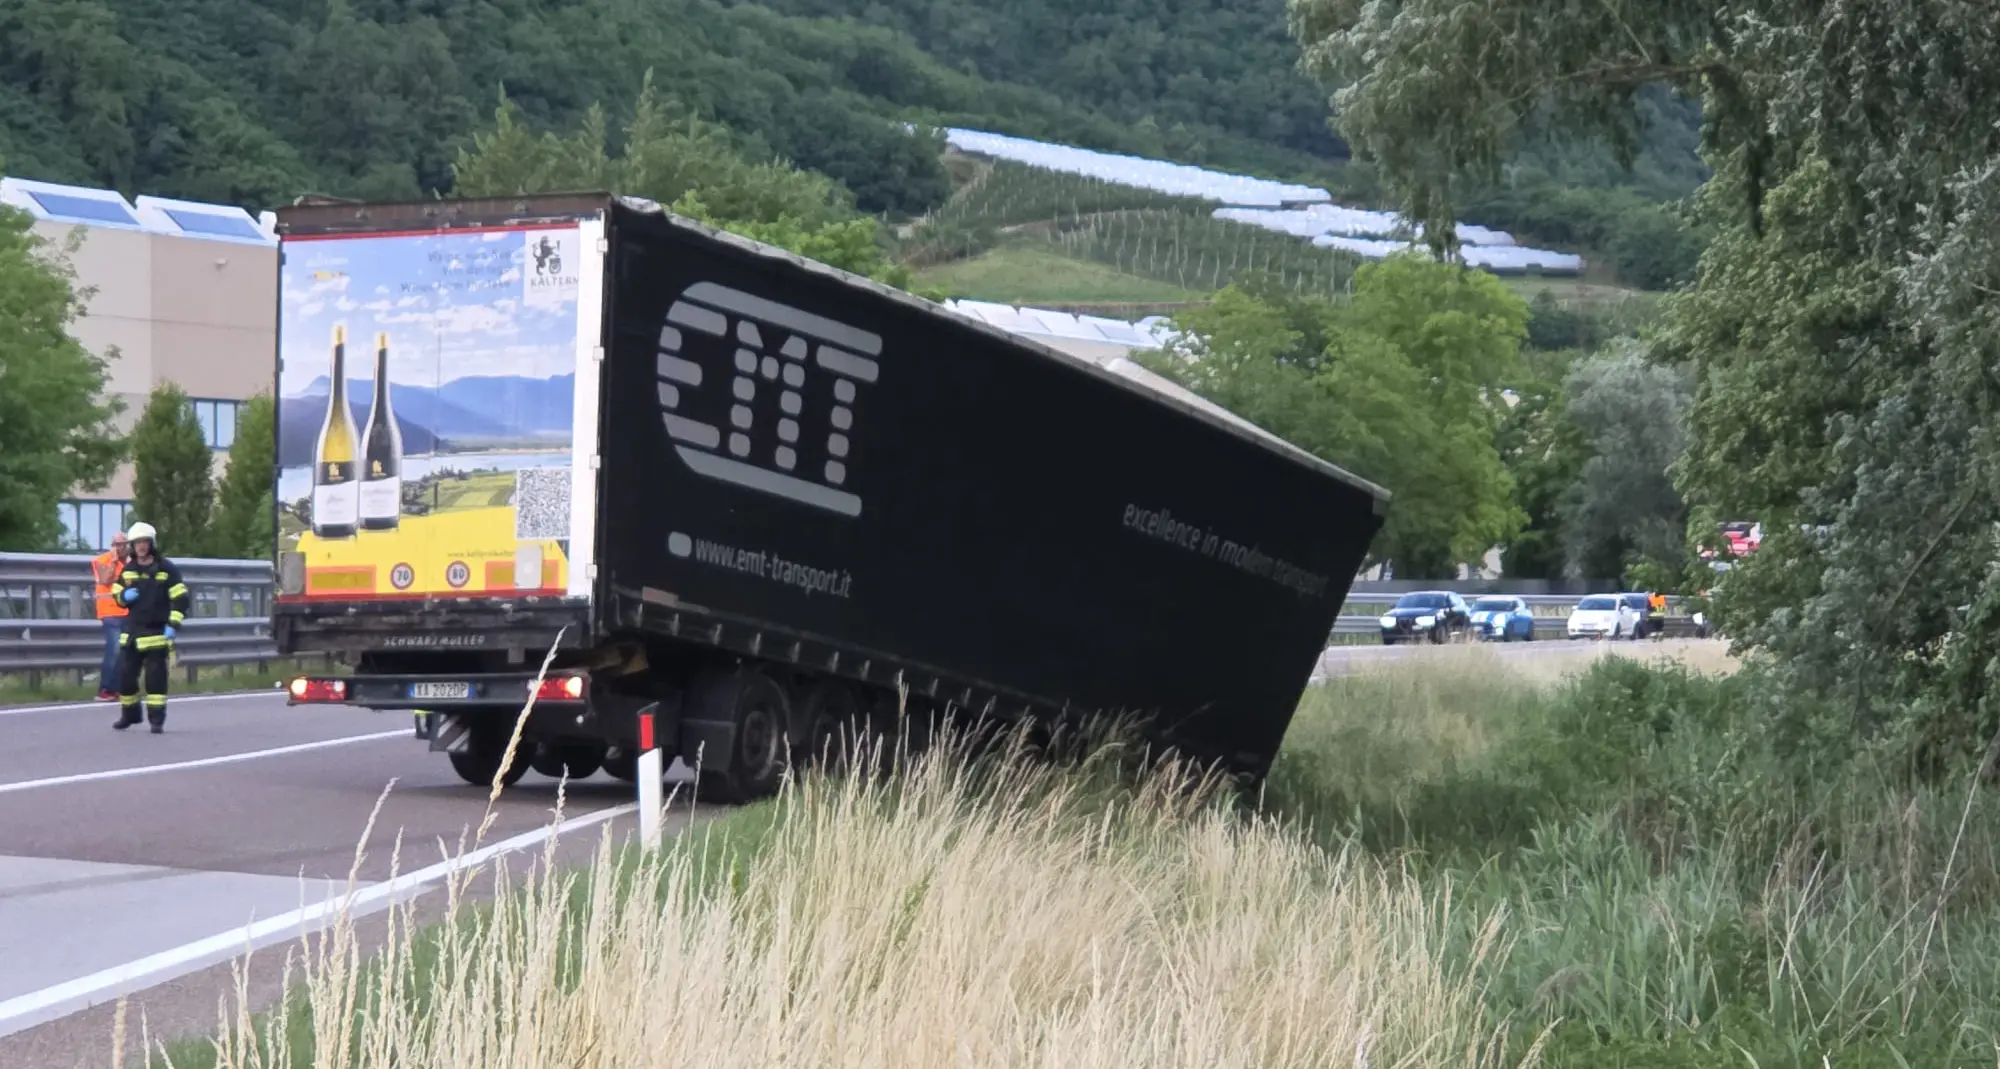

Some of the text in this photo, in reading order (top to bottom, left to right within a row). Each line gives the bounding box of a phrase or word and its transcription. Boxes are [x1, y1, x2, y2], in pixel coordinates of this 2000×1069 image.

[530, 276, 579, 287] KALTERN
[657, 300, 880, 485] EMT
[1123, 503, 1200, 551] excellence
[1201, 526, 1219, 558] in
[695, 538, 852, 598] www.emt-transport.it
